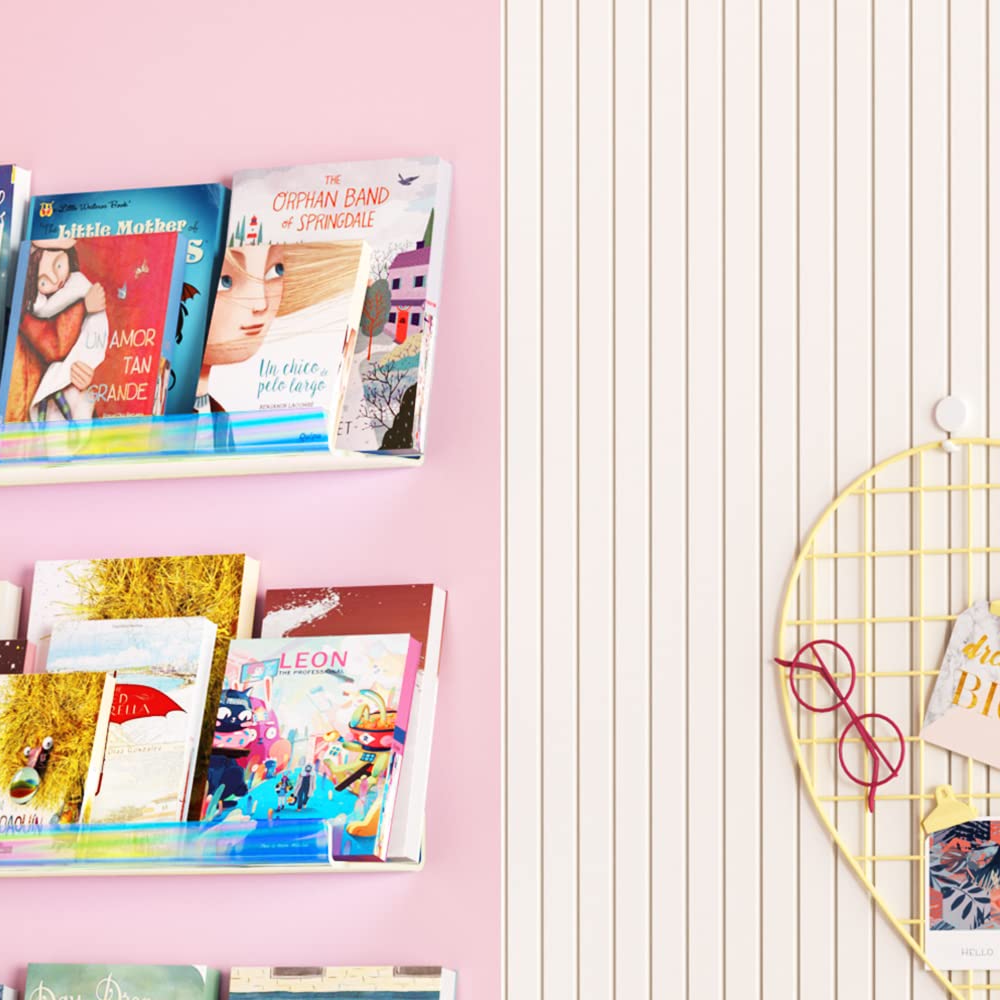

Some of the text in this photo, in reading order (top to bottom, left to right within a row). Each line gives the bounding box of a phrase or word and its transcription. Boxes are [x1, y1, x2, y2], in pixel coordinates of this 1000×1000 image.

[324, 174, 342, 185] THE
[272, 186, 390, 212] ORPHAN BAND
[57, 222, 111, 240] Little
[116, 218, 187, 235] Mother
[281, 210, 376, 231] of SPRINGDALE
[85, 328, 156, 349] UN AMOR
[124, 355, 152, 375] TAN
[259, 358, 279, 377] Un
[283, 358, 319, 376] chico
[85, 382, 149, 403] GRANDE
[257, 377, 327, 399] pelo largo
[279, 651, 348, 669] LEON
[962, 634, 1000, 666] dre
[952, 669, 1000, 720] BI
[961, 948, 994, 957] HELLO
